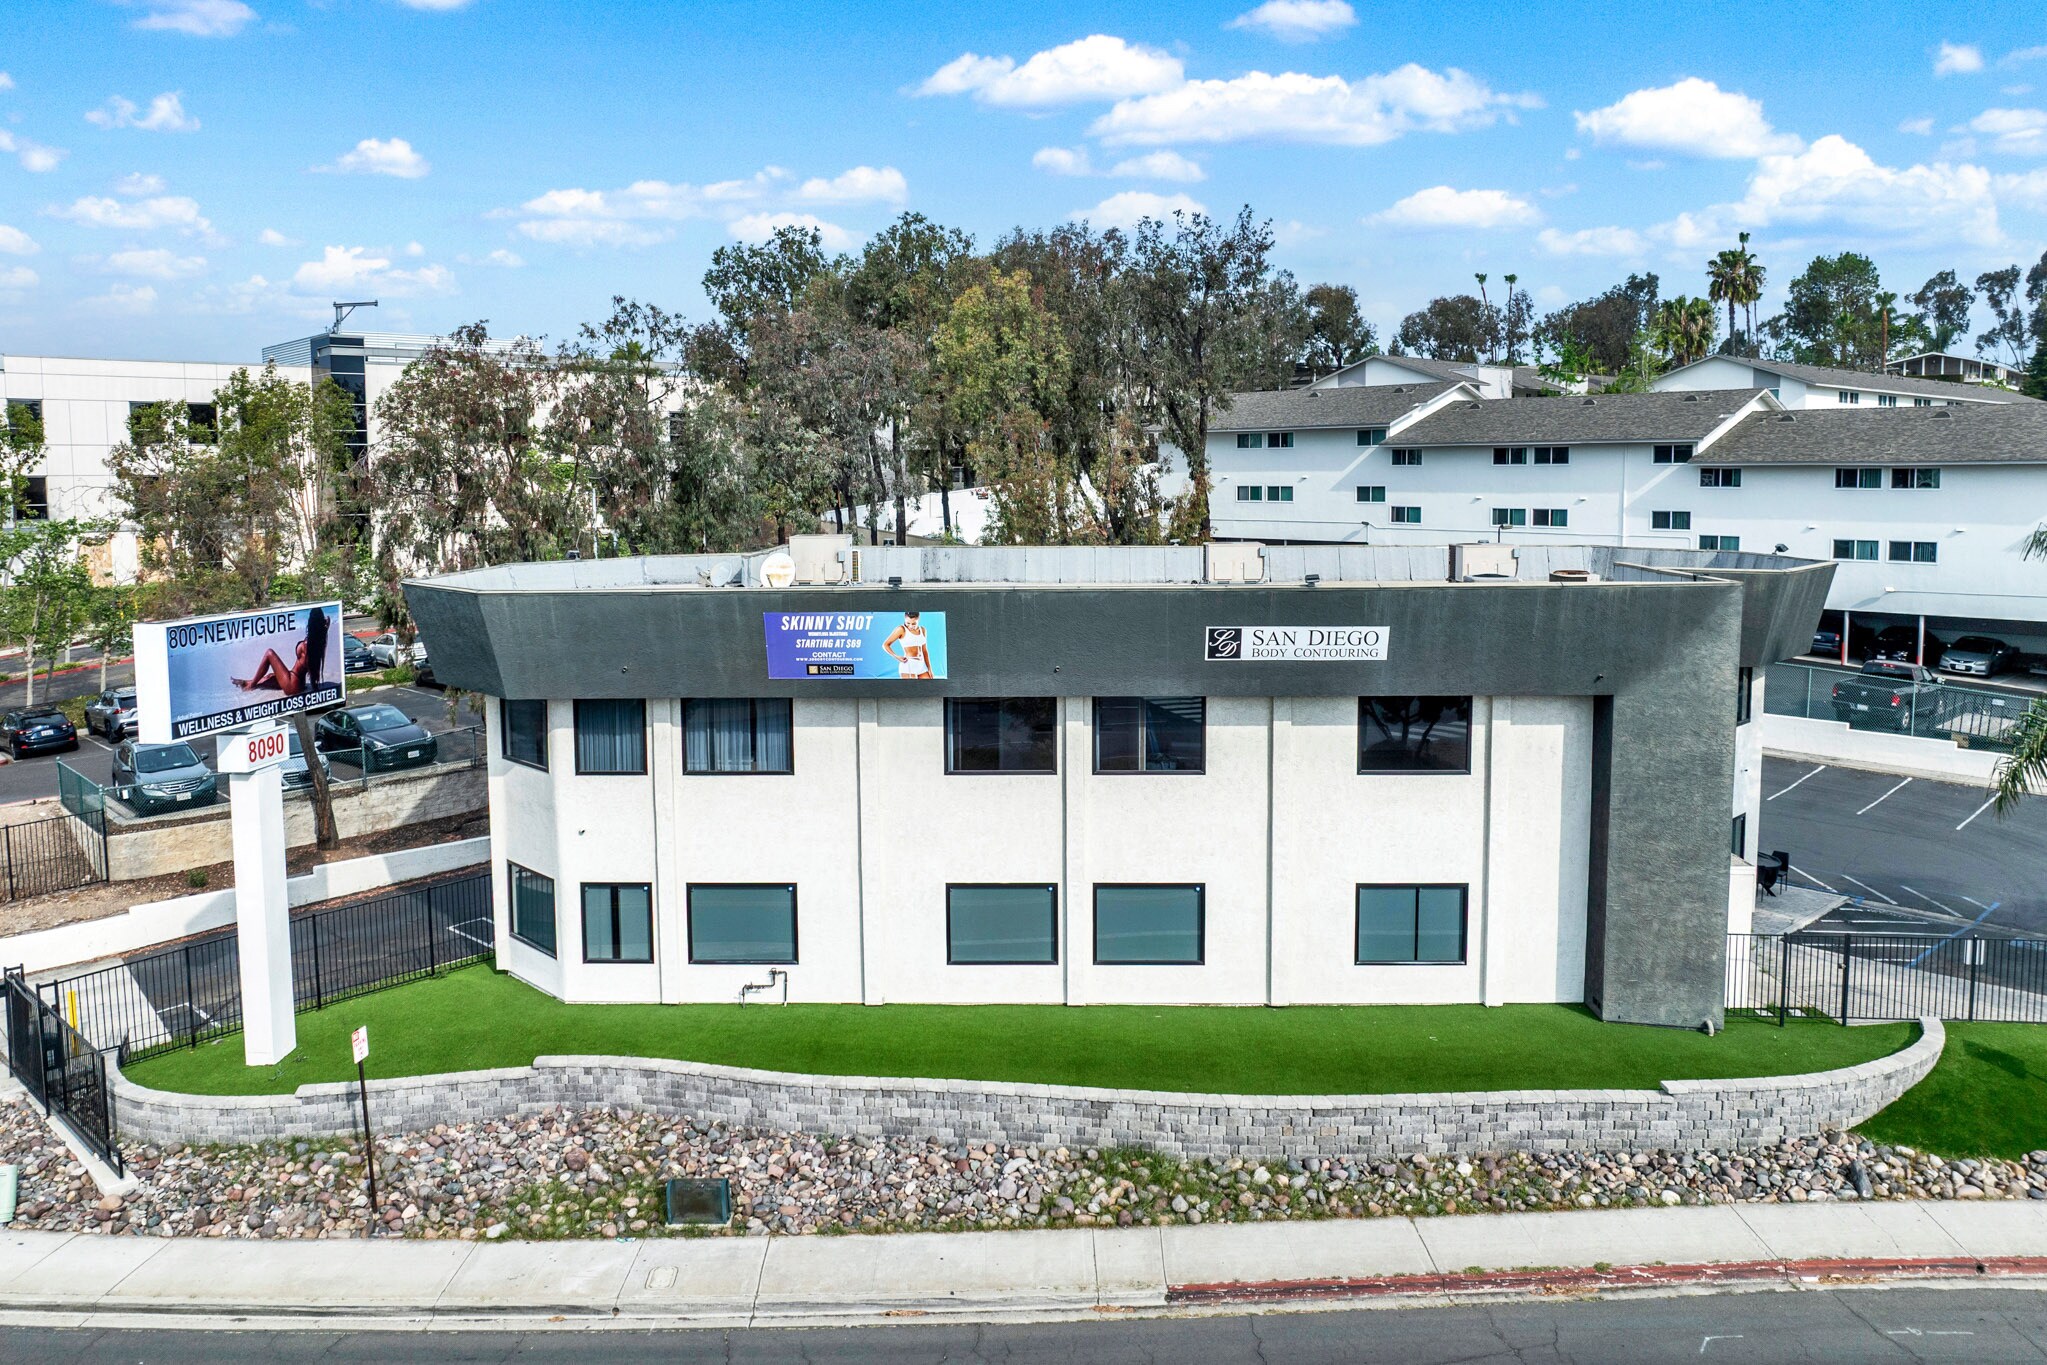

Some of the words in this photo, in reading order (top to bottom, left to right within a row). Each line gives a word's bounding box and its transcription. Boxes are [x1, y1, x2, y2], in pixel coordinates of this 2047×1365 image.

[169, 613, 297, 649] 800-NEWFIGURE
[781, 615, 834, 630] SKINNY
[836, 615, 873, 630] SHOT
[795, 638, 834, 648] STARTING
[834, 638, 846, 648] AT
[1252, 629, 1297, 646] SAN
[1308, 629, 1380, 646] DIEGO
[1251, 648, 1288, 658] BODY
[1293, 647, 1380, 658] CONTOURING
[178, 713, 234, 736] WELLNESS
[235, 710, 243, 723] &
[244, 701, 280, 720] WEIGHT
[281, 695, 304, 712] LOSS
[304, 688, 338, 706] CENTER
[248, 733, 285, 763] 8090
